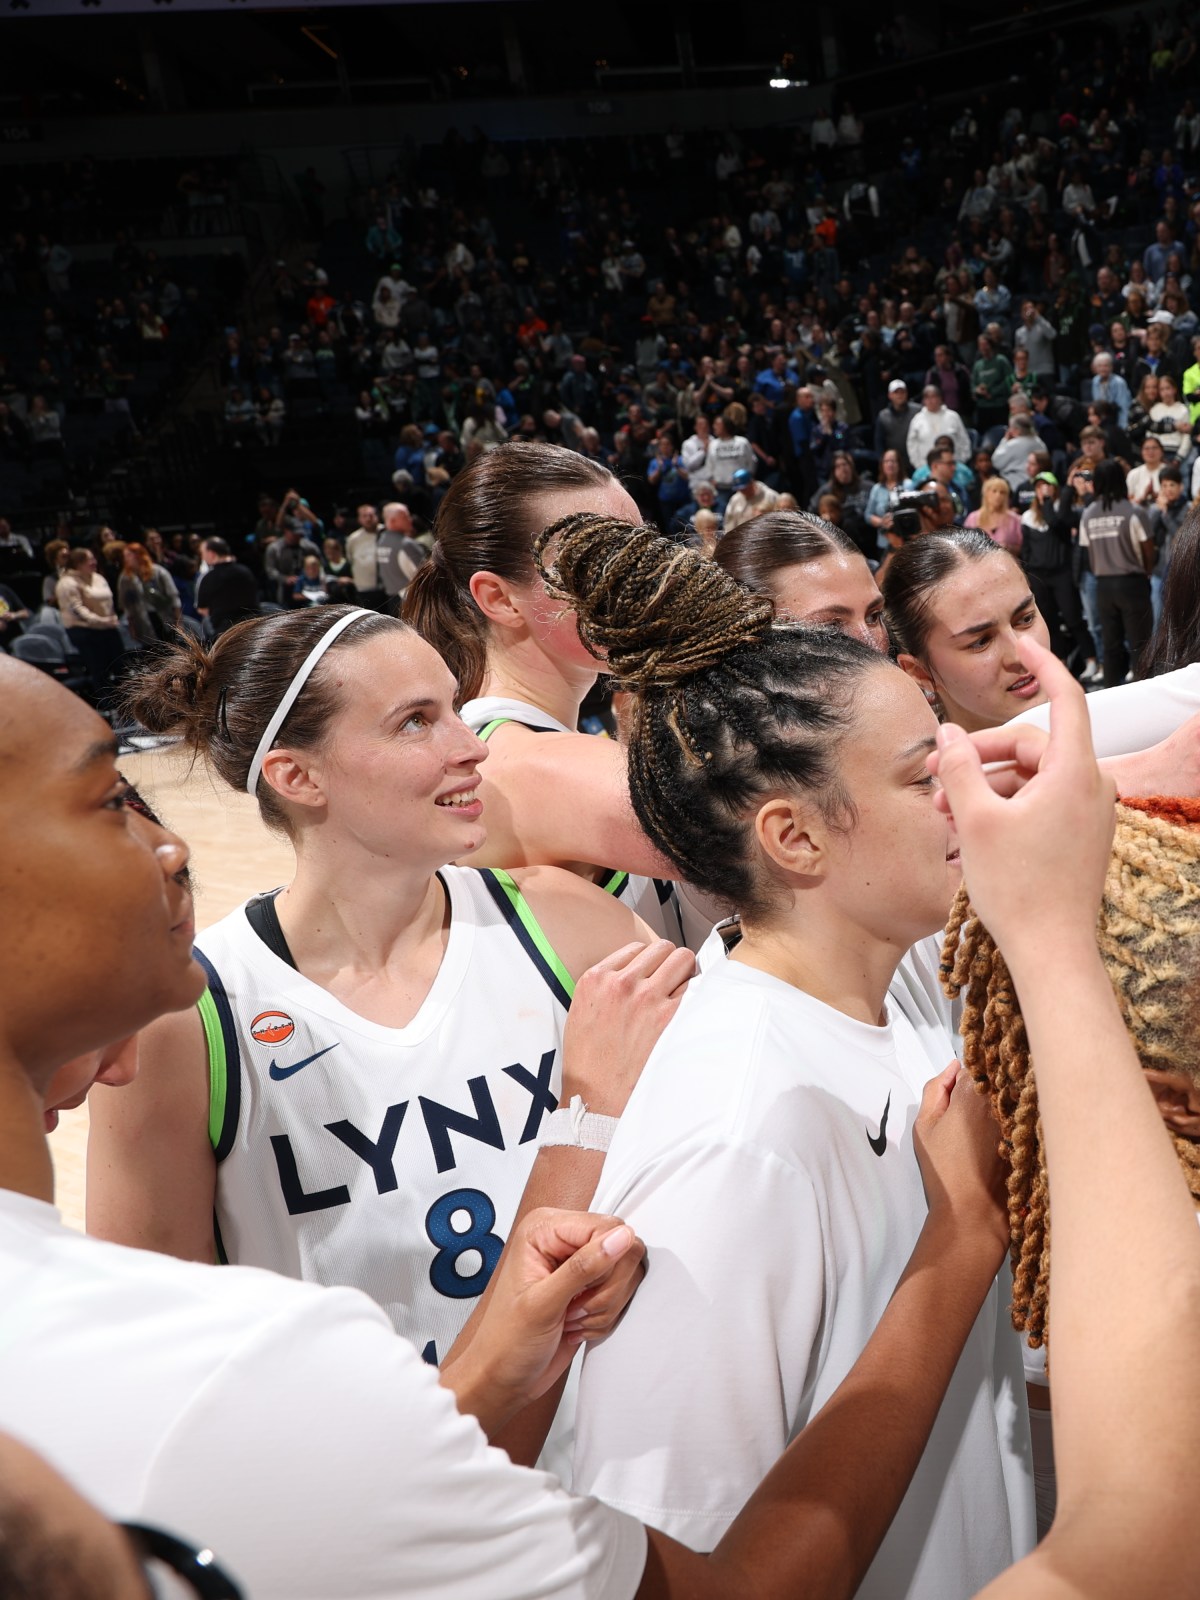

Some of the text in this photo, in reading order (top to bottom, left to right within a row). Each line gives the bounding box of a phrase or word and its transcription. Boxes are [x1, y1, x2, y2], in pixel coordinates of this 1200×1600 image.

[3, 127, 30, 140] 104
[270, 1049, 557, 1215] LYNX
[425, 1187, 503, 1299] 8
